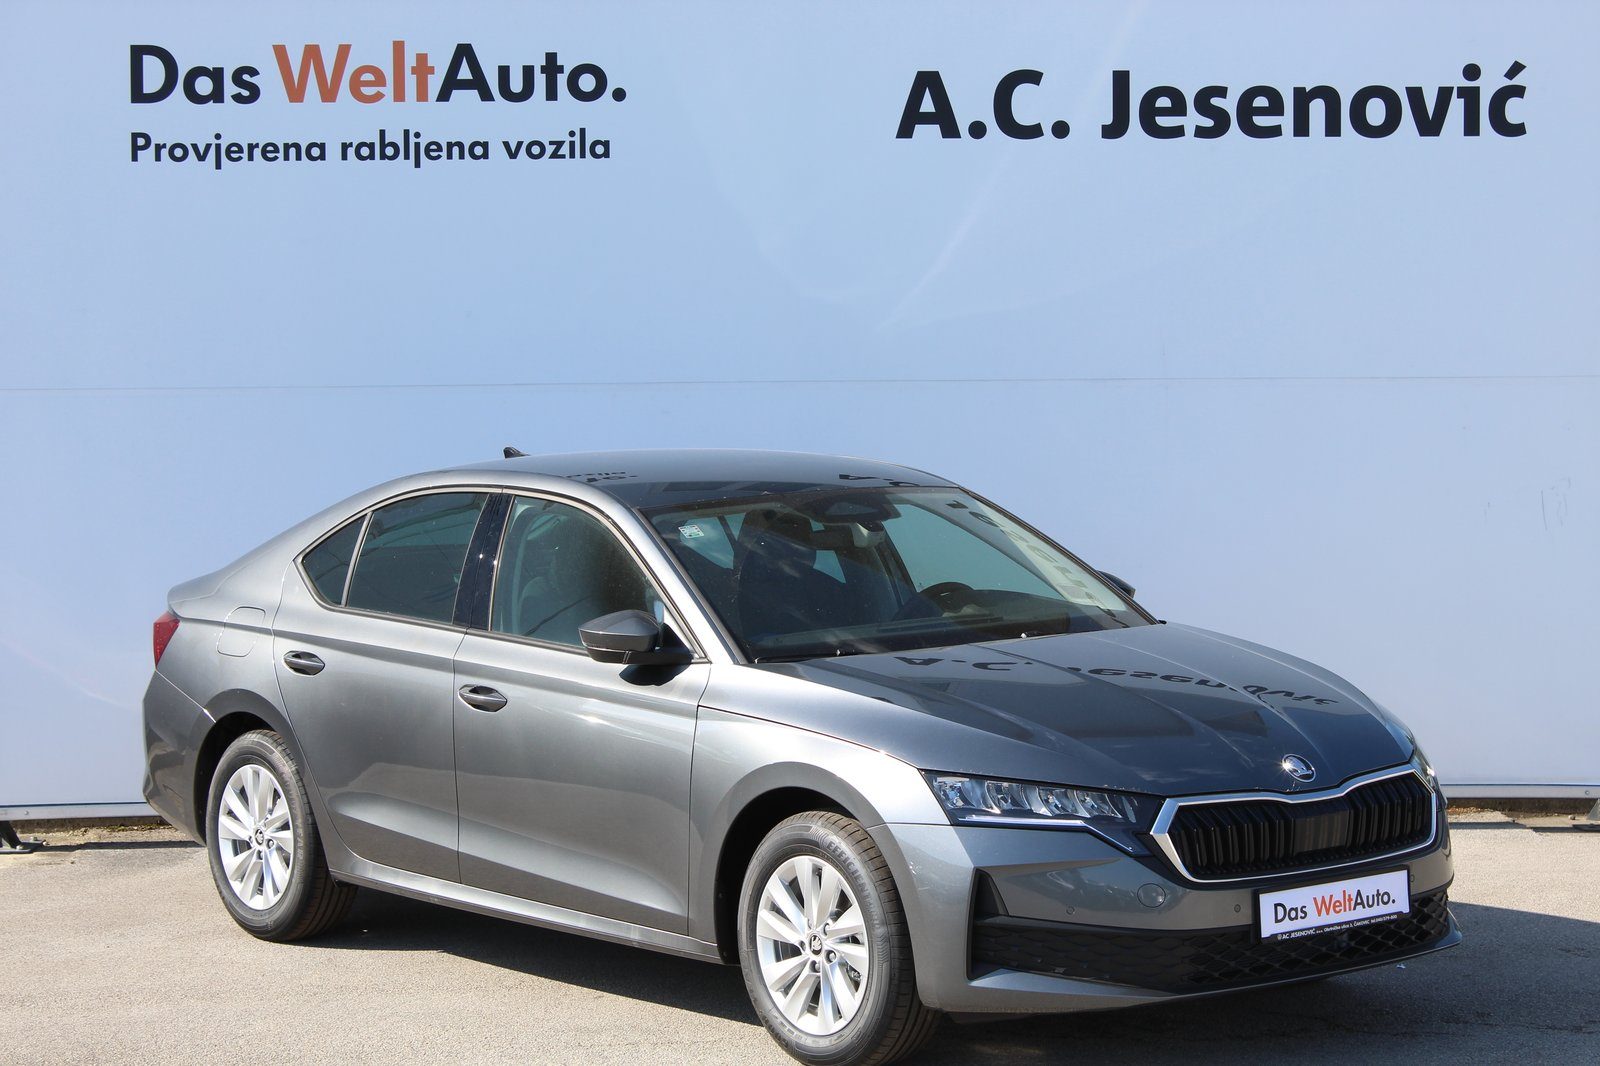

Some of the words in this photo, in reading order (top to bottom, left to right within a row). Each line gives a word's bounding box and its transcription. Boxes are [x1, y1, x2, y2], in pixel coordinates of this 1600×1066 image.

[130, 44, 260, 105] Das
[272, 40, 627, 104] WeltAuto.
[896, 69, 1071, 140] A.C.
[1101, 60, 1527, 140] Jesenović
[130, 131, 326, 171] Provjerena
[340, 128, 490, 169] rabljena
[501, 127, 611, 162] vozila
[1273, 902, 1308, 924] Das
[1312, 888, 1396, 917] WeltAuto.
